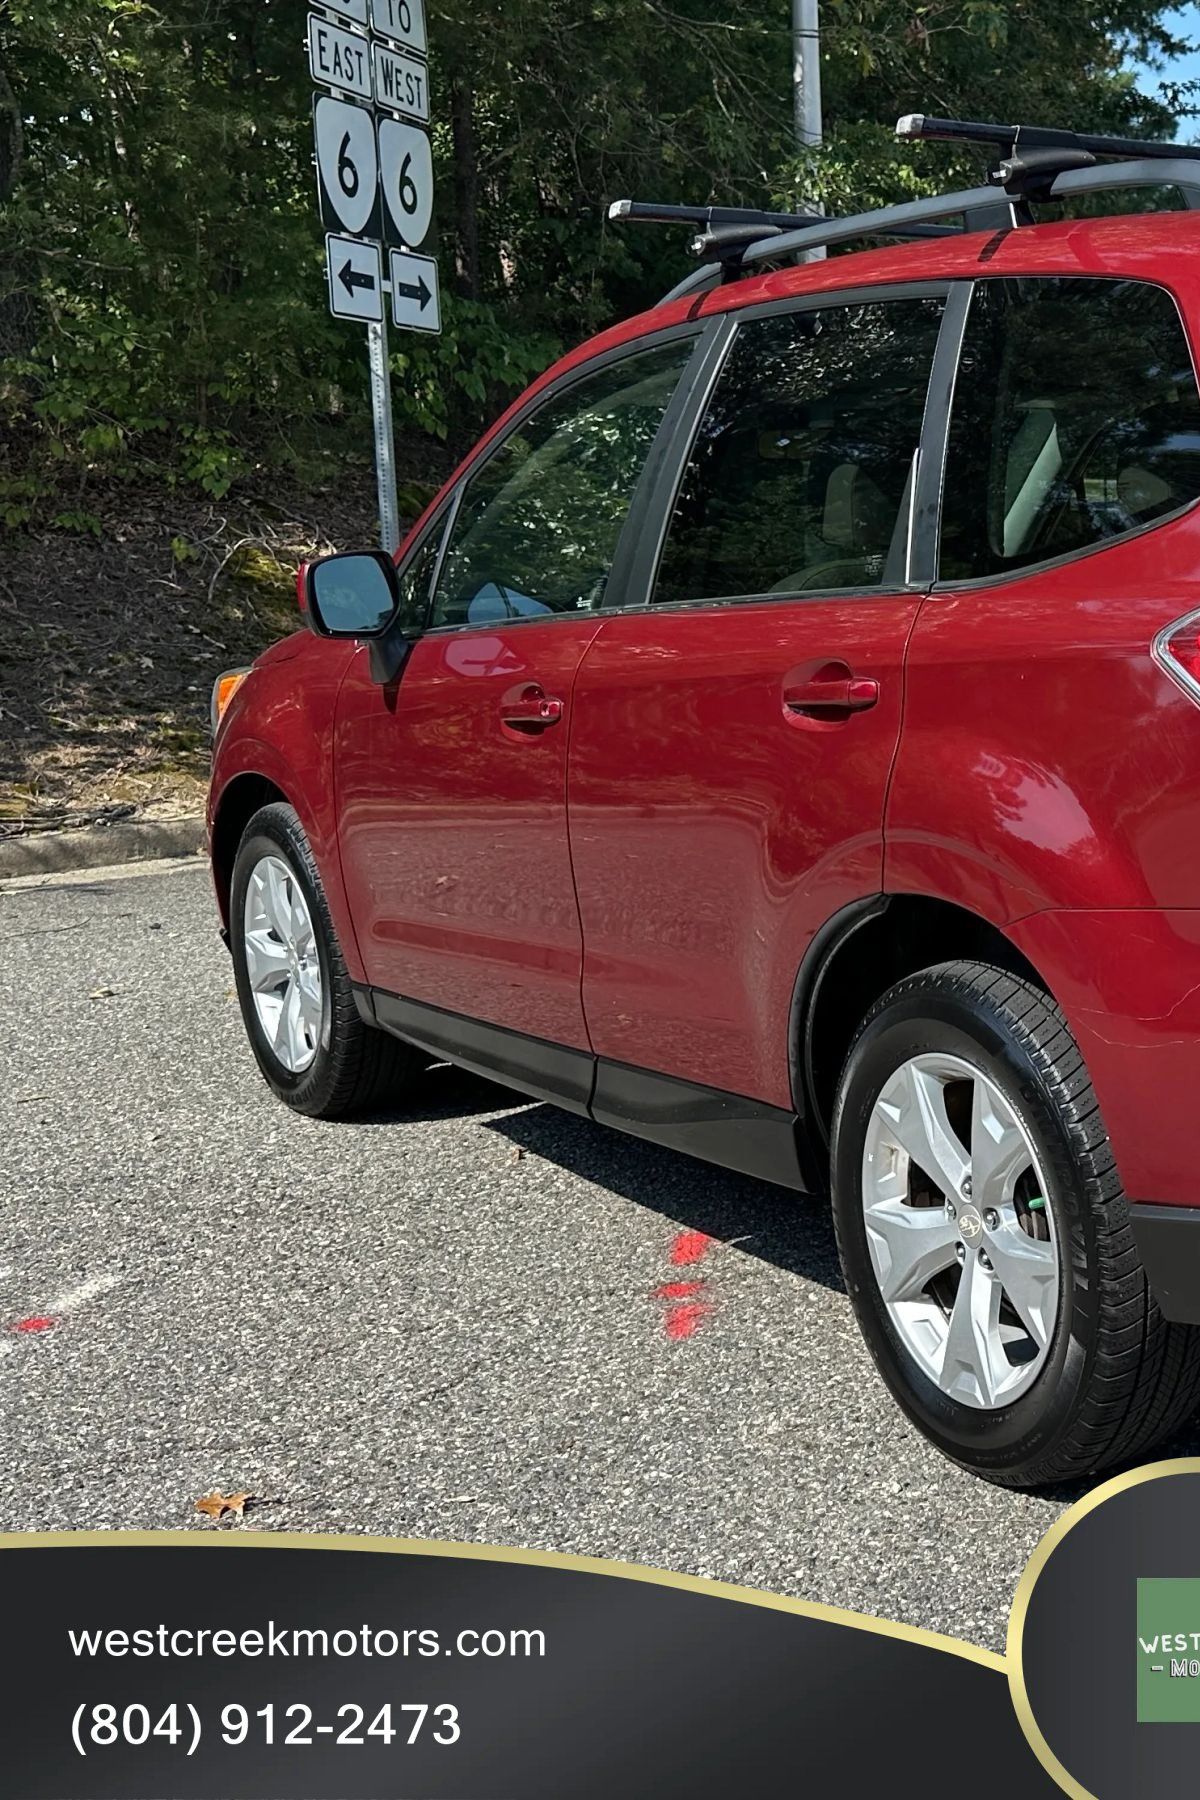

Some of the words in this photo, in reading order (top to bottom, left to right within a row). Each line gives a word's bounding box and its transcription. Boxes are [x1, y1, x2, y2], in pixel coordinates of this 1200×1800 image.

[318, 29, 364, 86] EAST
[380, 55, 423, 110] WEST
[337, 130, 359, 198] 6
[398, 152, 418, 215] 6
